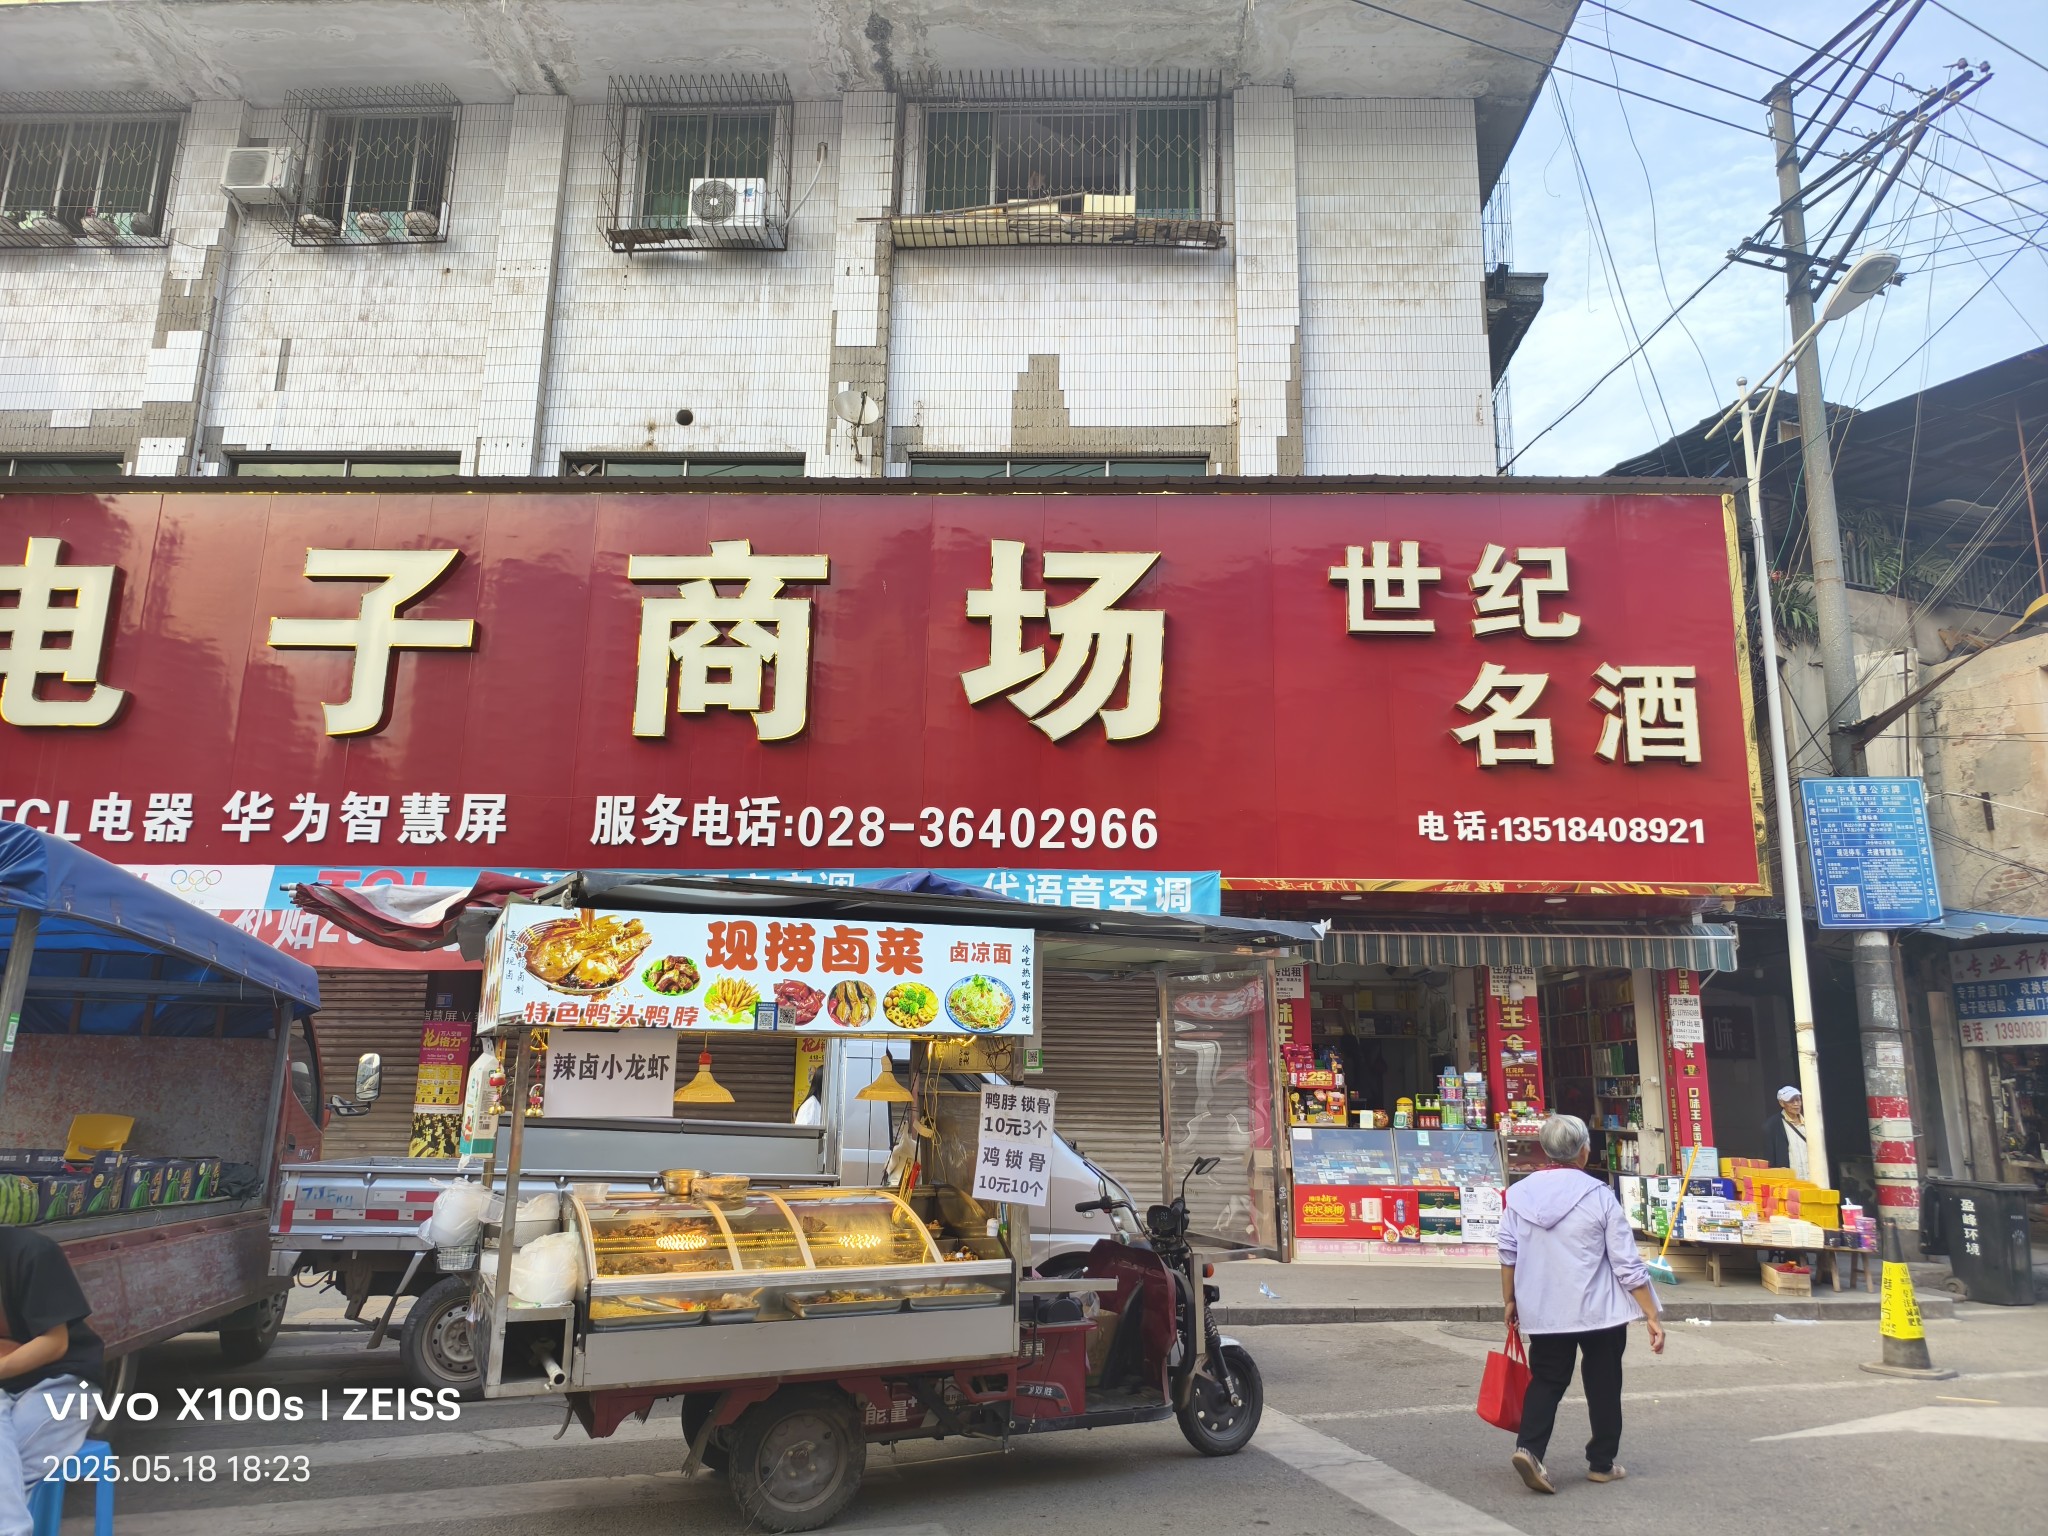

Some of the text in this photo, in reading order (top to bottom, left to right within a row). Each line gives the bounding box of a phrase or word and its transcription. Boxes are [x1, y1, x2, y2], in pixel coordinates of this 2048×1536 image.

[1328, 540, 1580, 638] 世纪
[1449, 661, 1702, 766] 名酒
[221, 790, 508, 845] 华为智慧屏
[590, 793, 1159, 850] 服务电话:028-36402966
[1418, 810, 1706, 844] 电话:13518408921
[705, 920, 925, 976] 现捞卤菜
[949, 940, 1013, 965] 卤凉面
[1021, 944, 1032, 1025] 冷吃热吃都好吃
[524, 1001, 701, 1028] 特色鸭头鸭脖
[552, 1052, 671, 1082] 辣卤小龙虾
[983, 1116, 1048, 1139] 10元3个
[982, 1146, 1046, 1173] 鸡锁骨
[978, 1174, 1044, 1198] 10元10个
[1960, 1198, 1981, 1256] 盈峰环境
